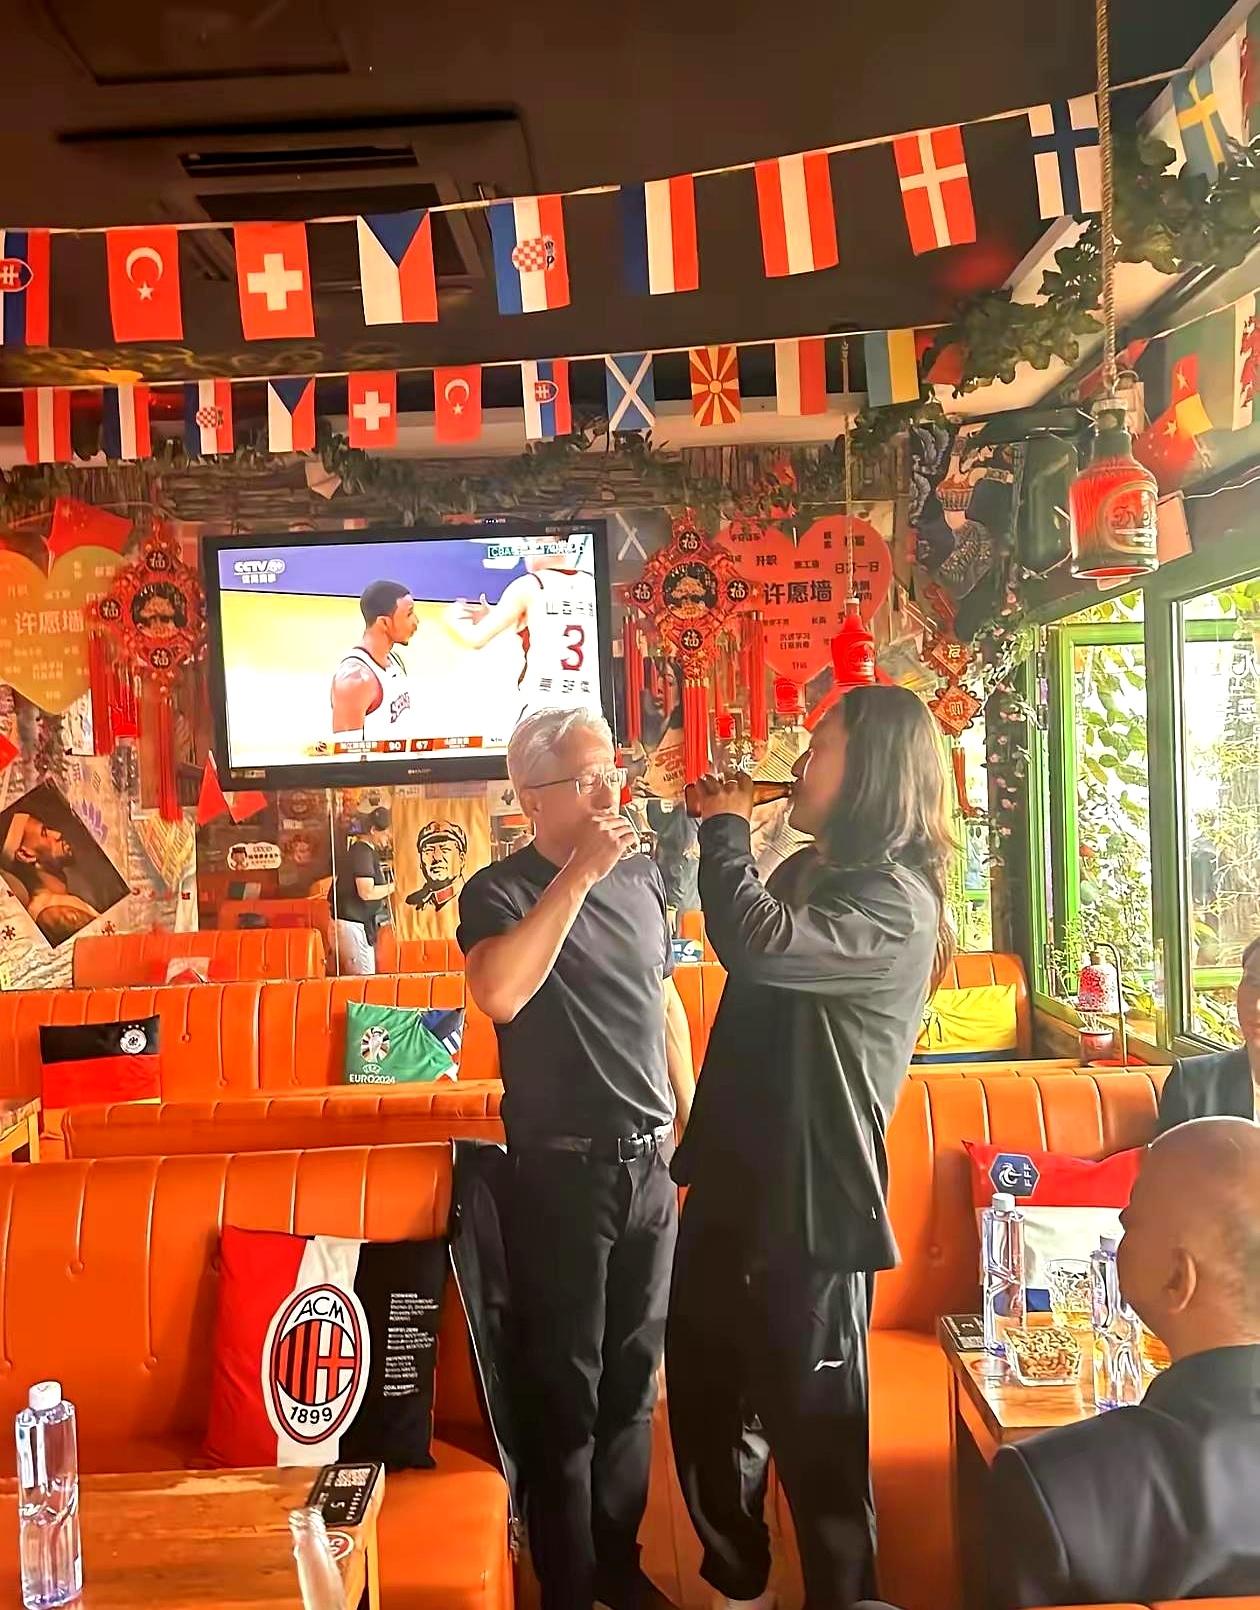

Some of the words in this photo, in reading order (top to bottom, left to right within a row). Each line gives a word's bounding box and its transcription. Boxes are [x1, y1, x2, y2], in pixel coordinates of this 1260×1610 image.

[764, 579, 832, 605] 许愿墙
[15, 608, 85, 635] 许愿墙
[560, 625, 585, 671] 3
[349, 1073, 395, 1084] EURO2024
[1023, 1162, 1033, 1187] FFF
[294, 1296, 345, 1325] ACM
[290, 1406, 333, 1425] 1899
